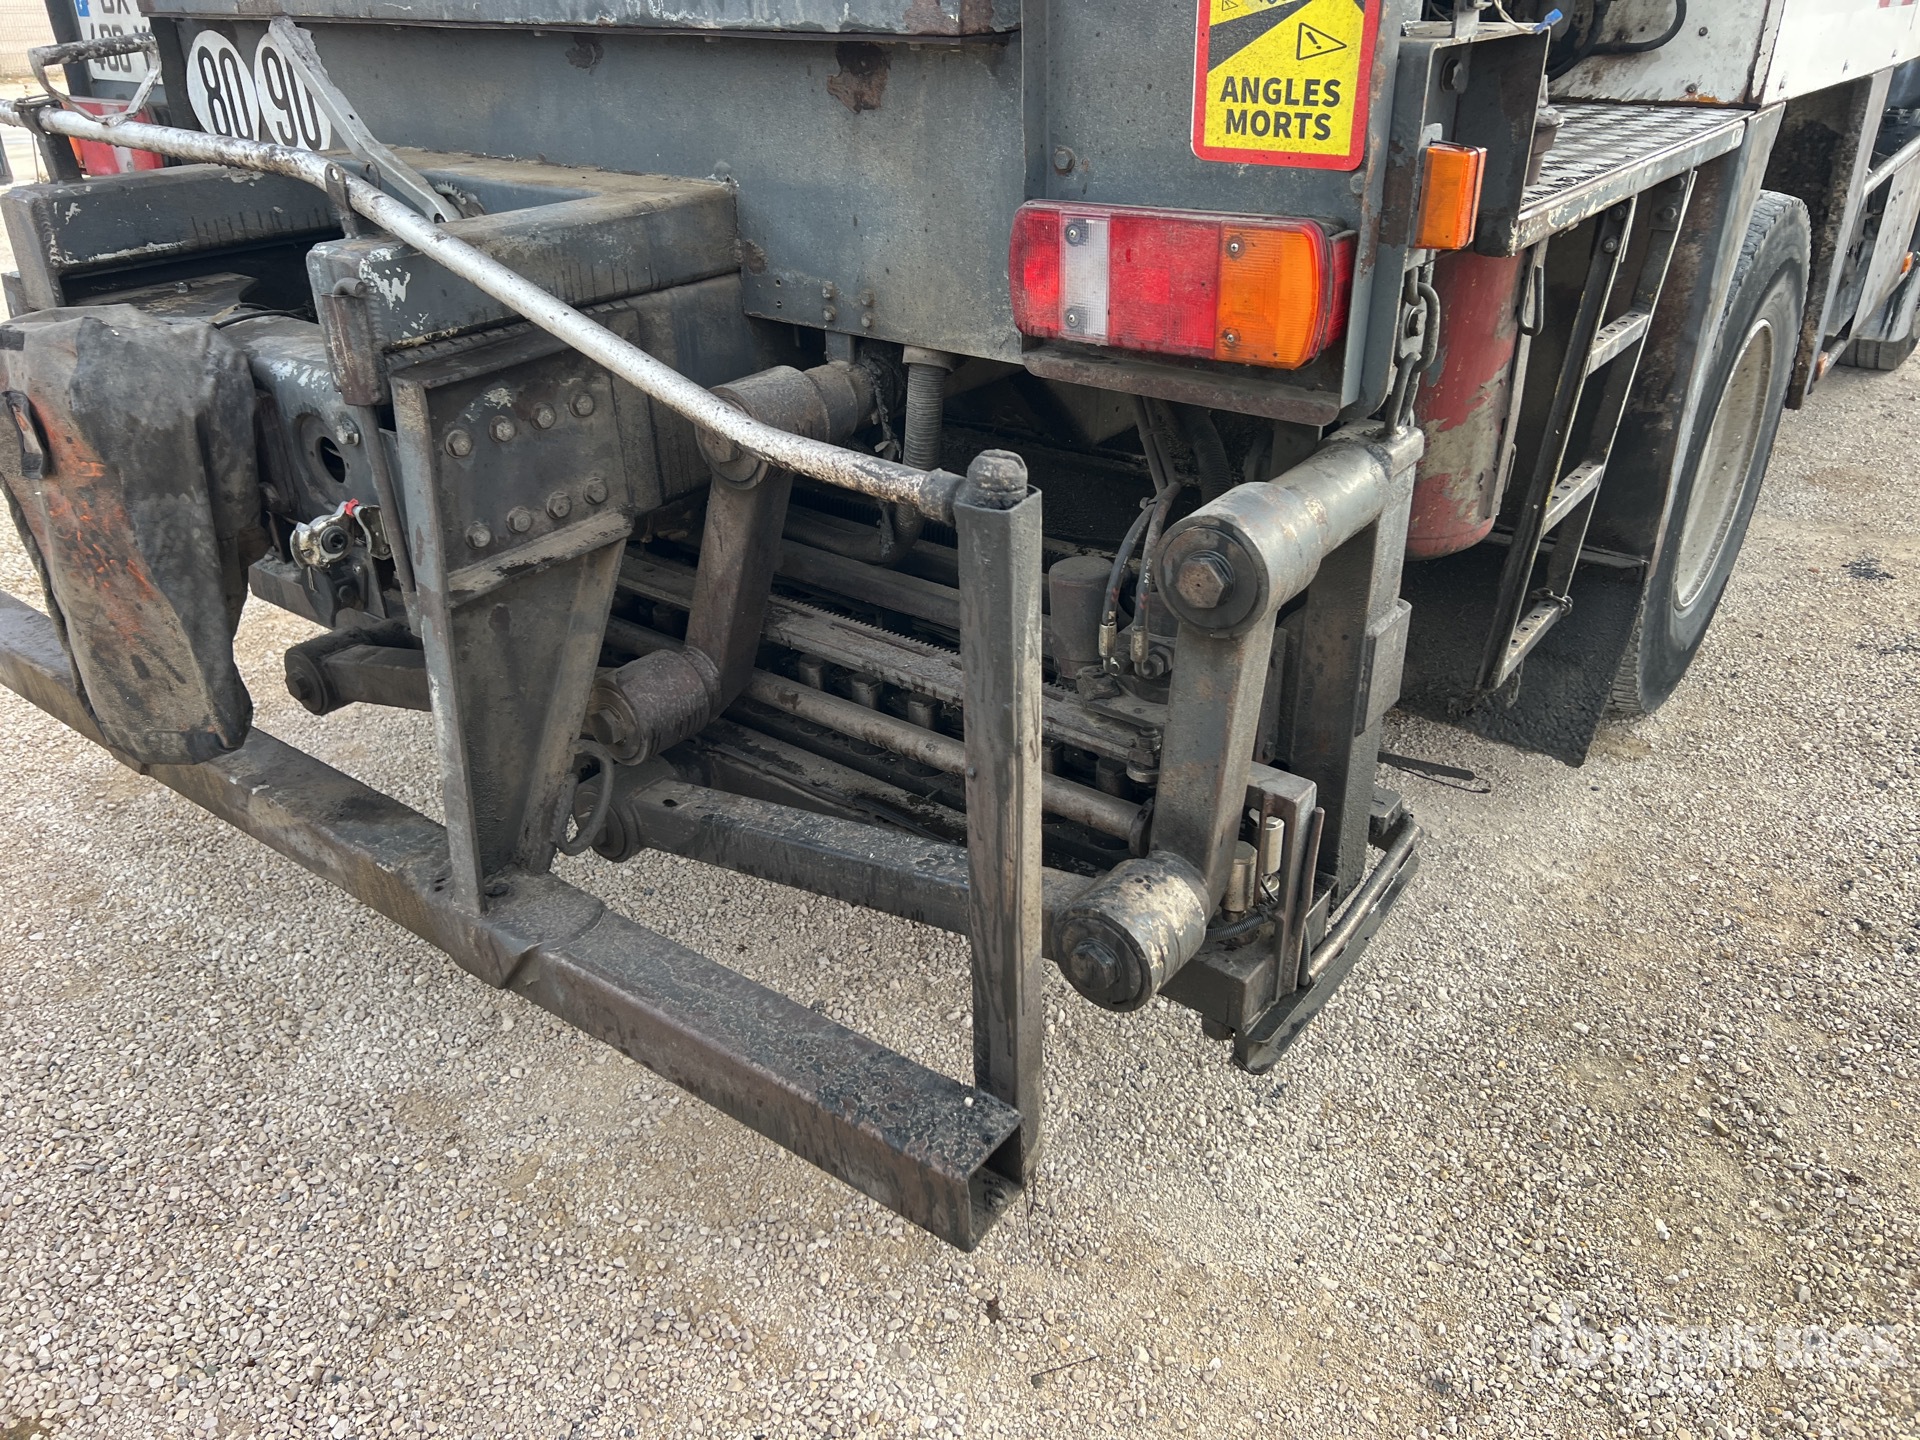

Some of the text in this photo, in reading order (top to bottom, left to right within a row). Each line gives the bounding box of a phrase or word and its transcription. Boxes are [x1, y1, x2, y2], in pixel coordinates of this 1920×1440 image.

[198, 46, 253, 141] 80
[261, 46, 321, 151] 90
[1219, 76, 1341, 108] ANGLES
[1225, 109, 1332, 141] MORTS
